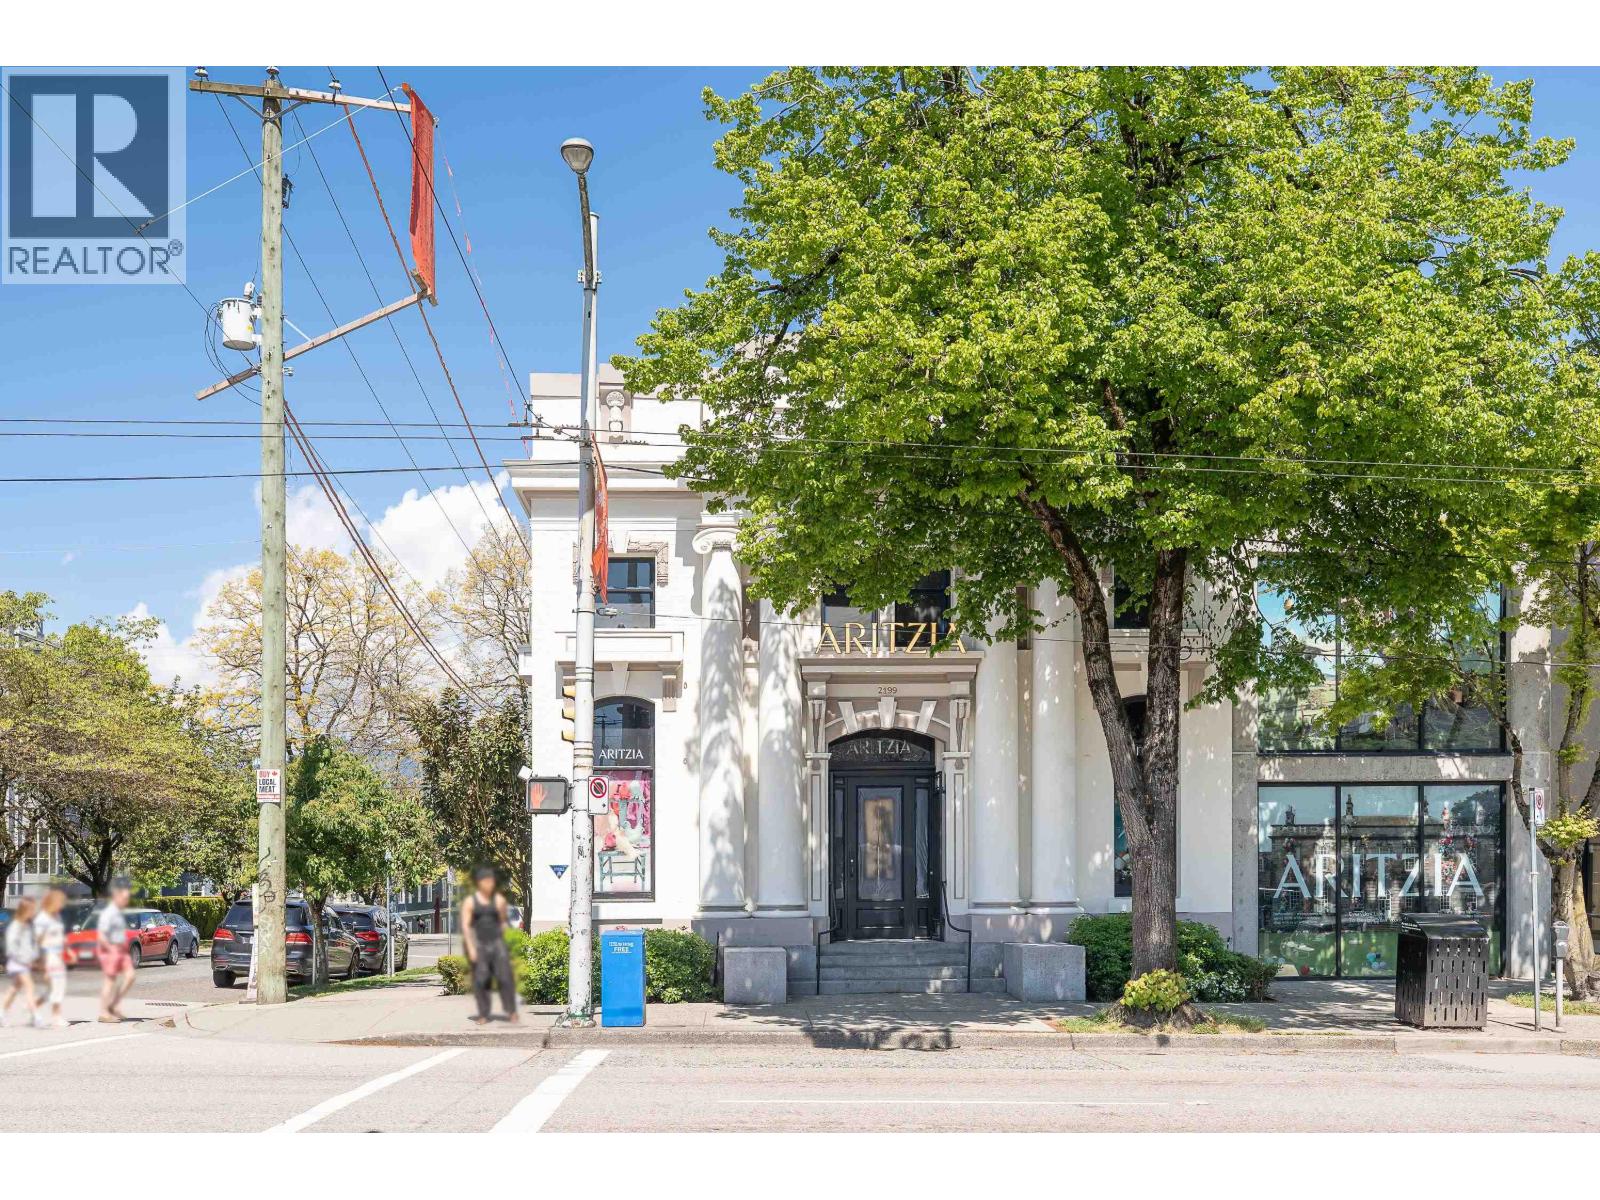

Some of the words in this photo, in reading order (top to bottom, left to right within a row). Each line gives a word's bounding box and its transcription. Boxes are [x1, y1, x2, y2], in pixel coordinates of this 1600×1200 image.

[815, 622, 967, 654] ARITZIA
[878, 686, 898, 694] 2199
[598, 749, 644, 760] ARITZIA
[259, 785, 275, 793] MEAT
[1273, 852, 1485, 898] ARITZIA
